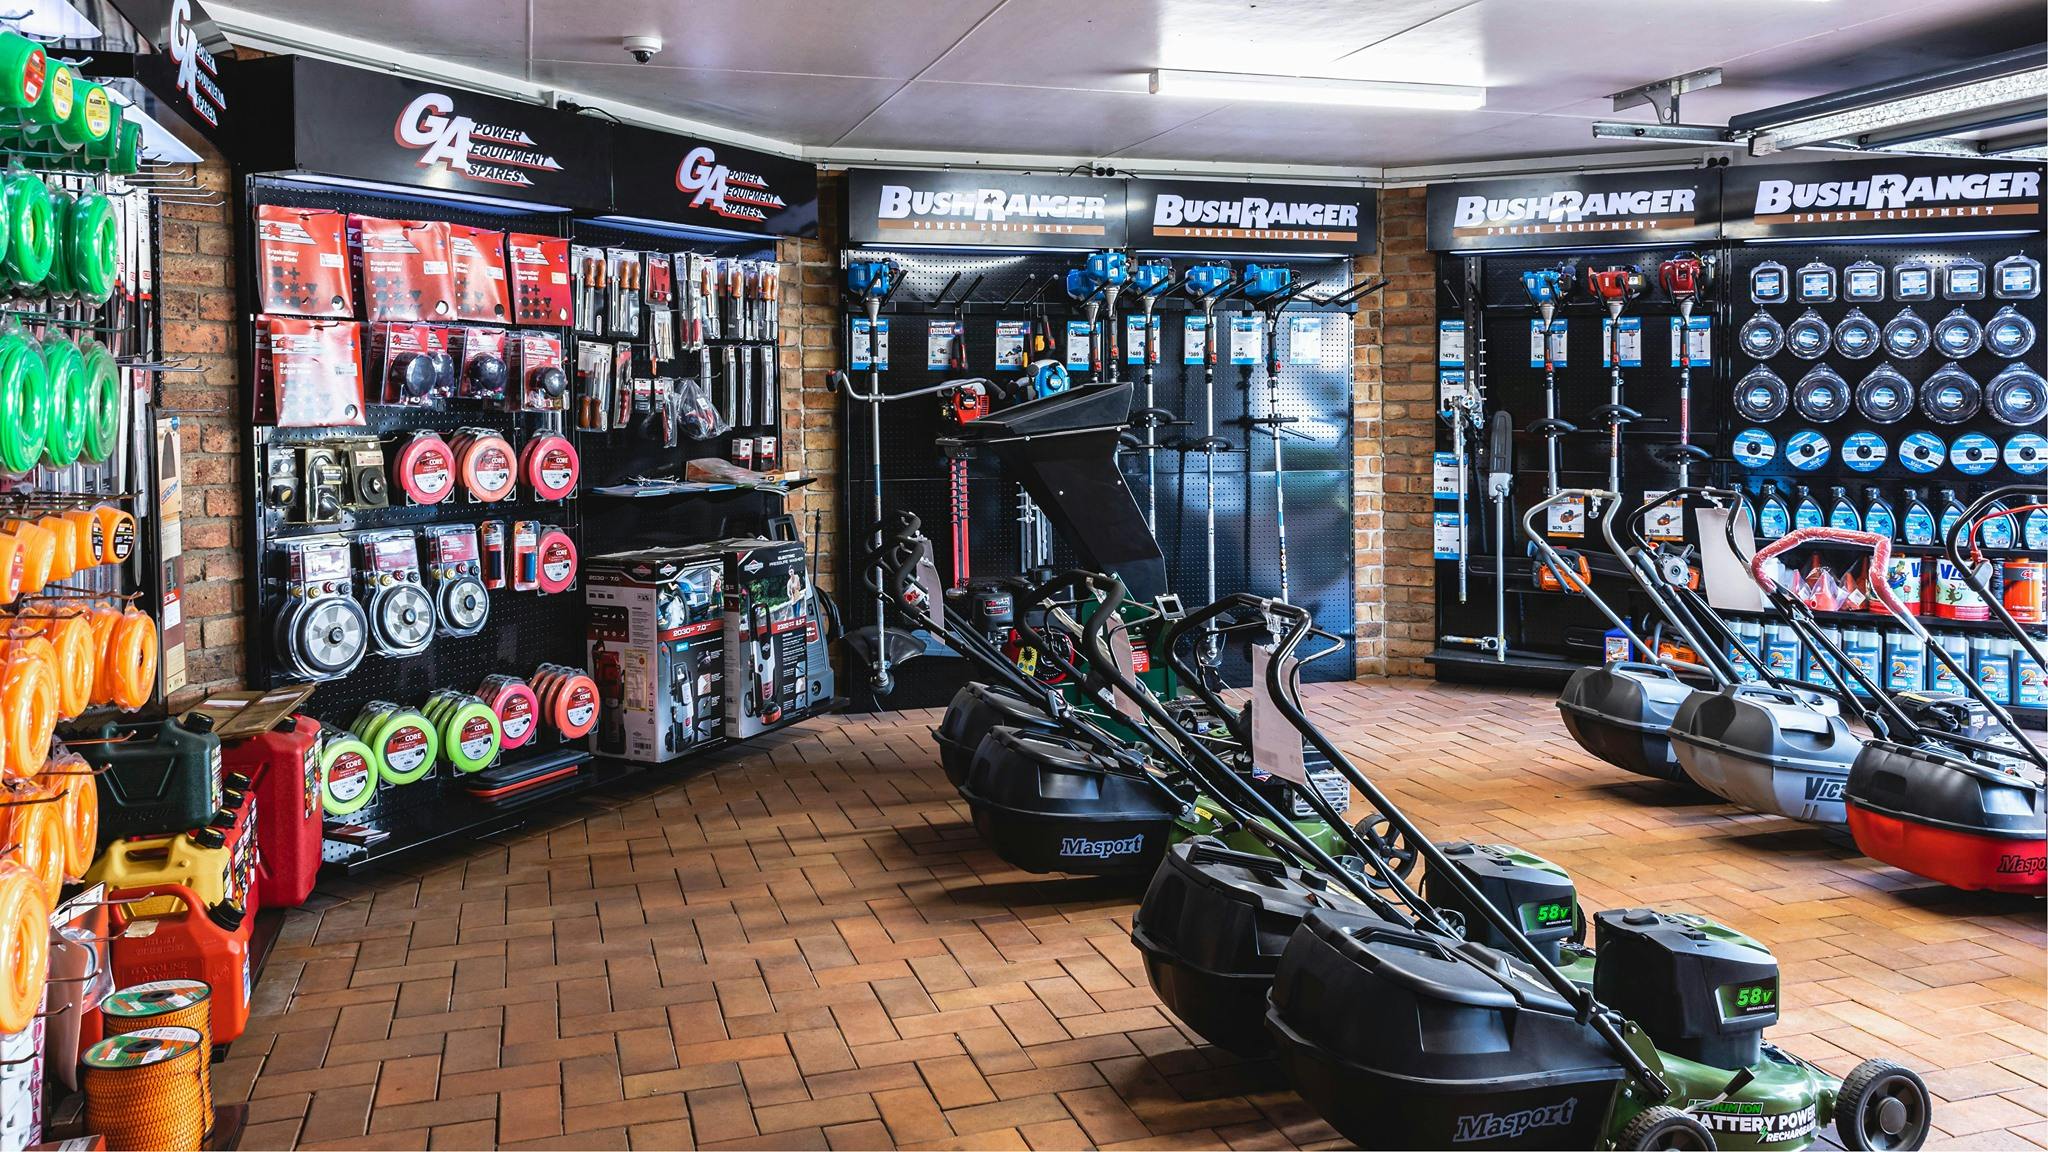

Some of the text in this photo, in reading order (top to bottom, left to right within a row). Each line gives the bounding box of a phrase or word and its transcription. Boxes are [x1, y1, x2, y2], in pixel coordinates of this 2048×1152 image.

[396, 93, 476, 170] GA
[473, 124, 522, 142] POWER
[470, 144, 549, 166] EQUIPMENT
[468, 164, 521, 182] SPARES
[677, 147, 727, 208] GA
[728, 171, 760, 183] POWER
[726, 187, 777, 203] EQUIPMENT
[725, 203, 759, 217] SPARES
[1794, 206, 1995, 222] POWER EQUIPMENT
[913, 221, 1074, 233] POWER EQUIPMENT
[1185, 229, 1330, 240] POWER EQUIPMENT
[1487, 220, 1657, 235] POWER EQUIPMENT
[672, 624, 707, 637] 2030 7.0
[1770, 652, 1784, 667] 2
[1892, 661, 1906, 677] 2
[1981, 666, 1997, 682] 2
[2021, 669, 2036, 685] 2
[474, 723, 488, 732] CORE
[405, 732, 422, 742] CORE
[345, 758, 362, 769] CORE
[1805, 777, 1848, 801] VICT
[1060, 834, 1144, 858] Masport
[1998, 855, 2047, 876] Maspo
[1741, 1102, 1763, 1115] ION
[1453, 1097, 1578, 1142] Masport
[1779, 1103, 1816, 1131] POWER
